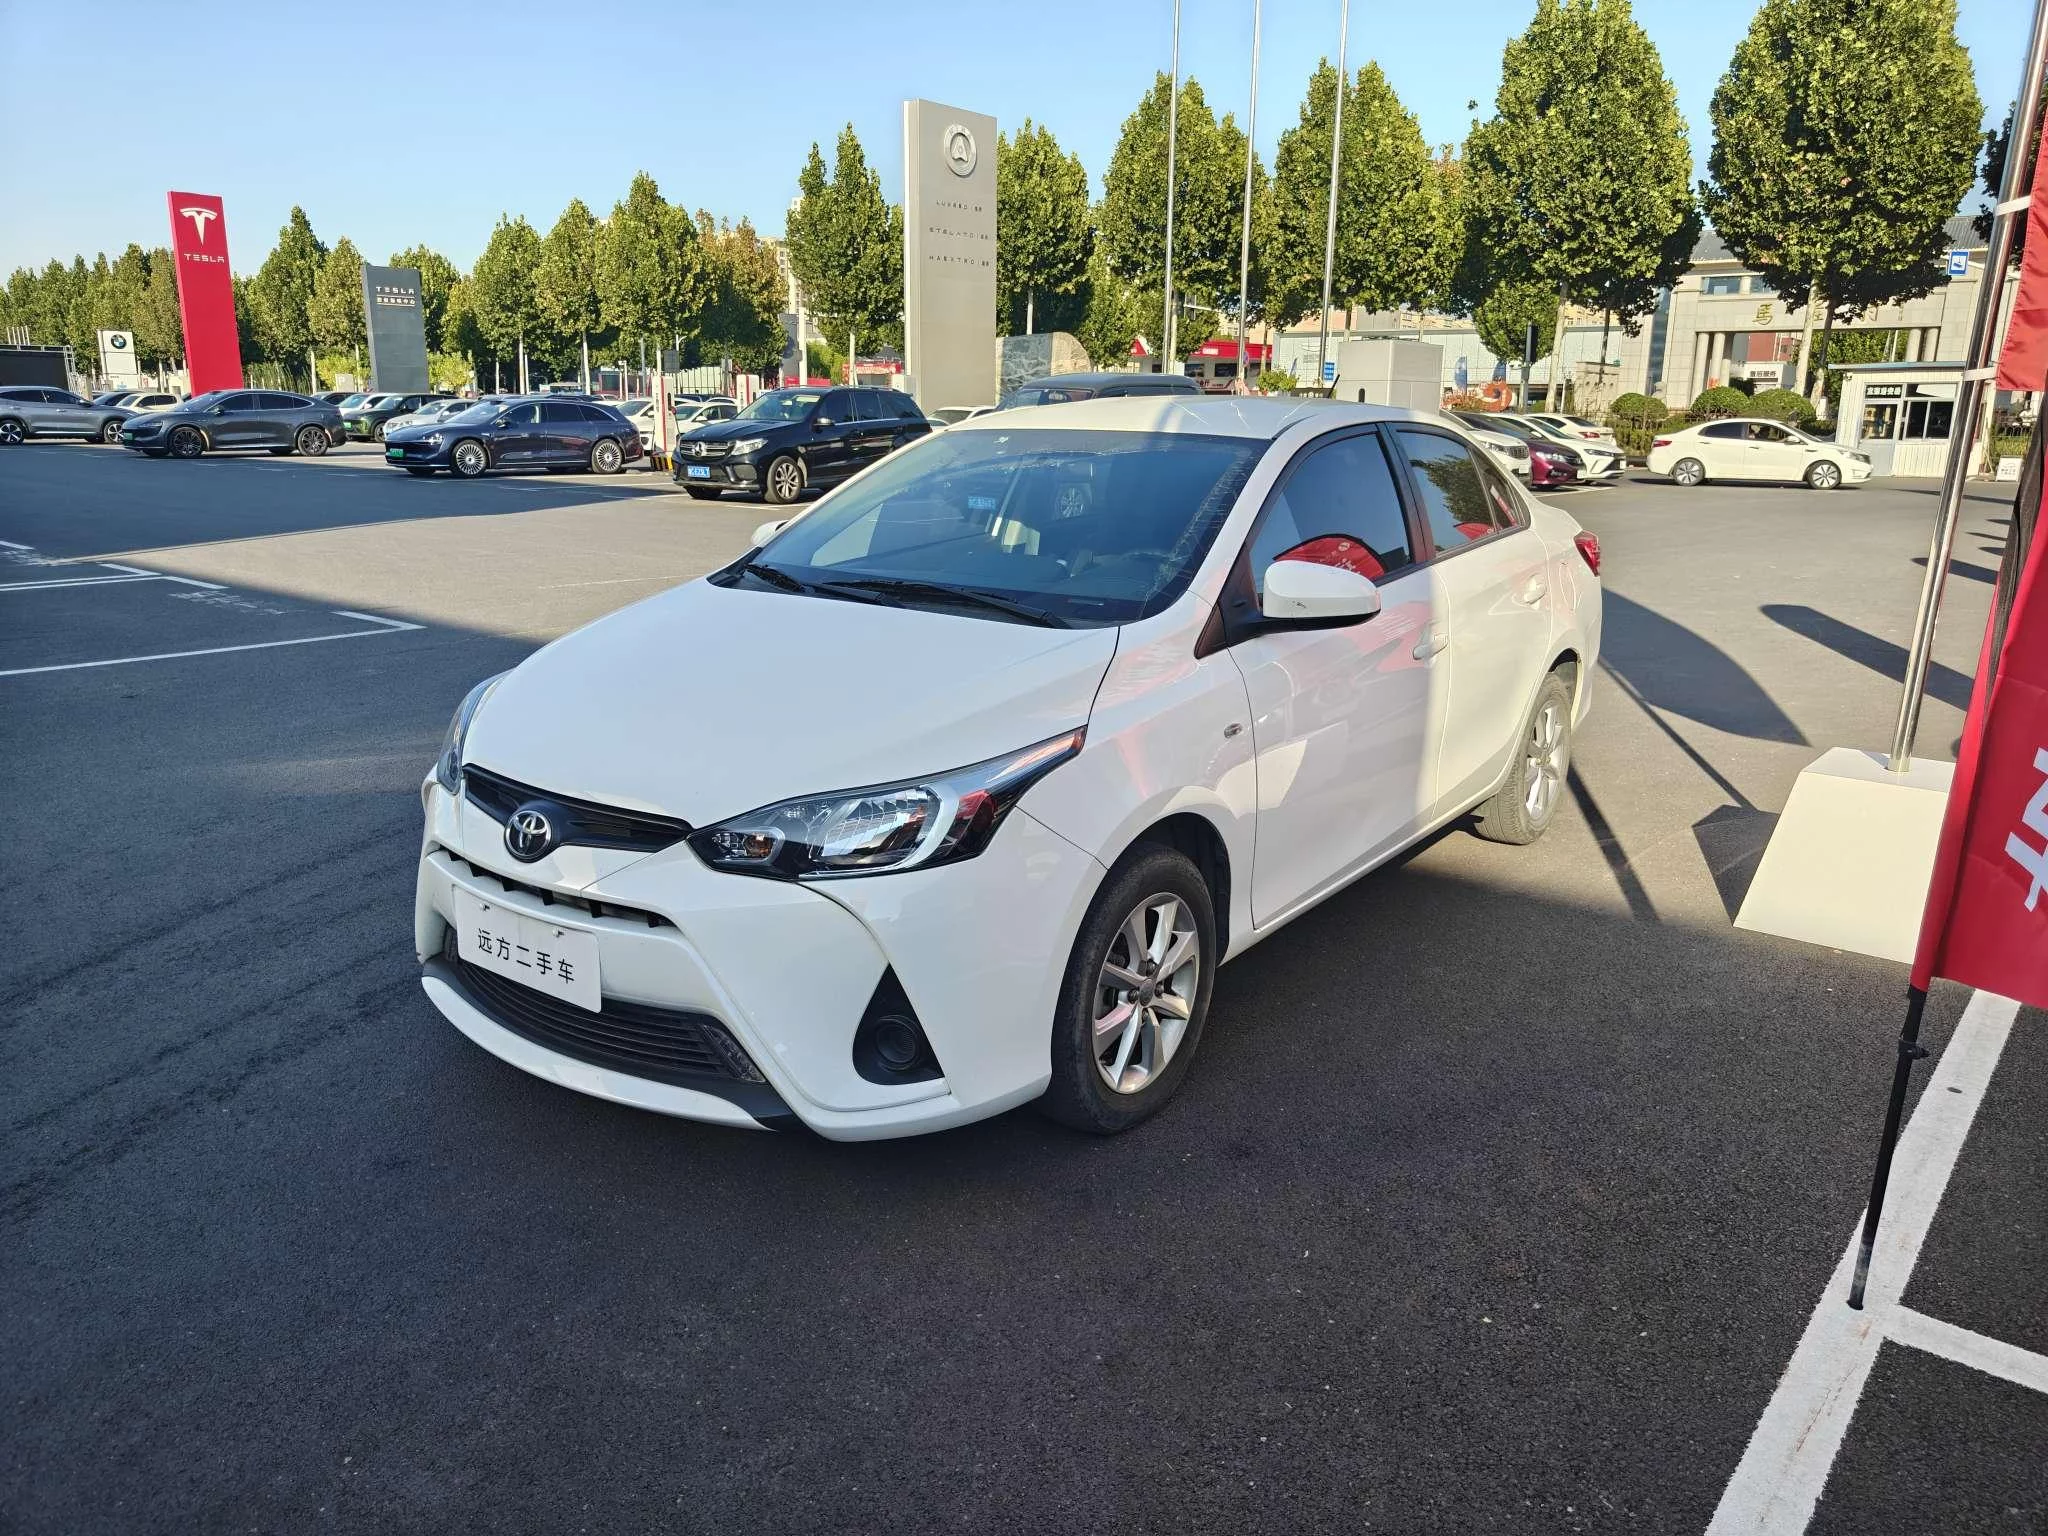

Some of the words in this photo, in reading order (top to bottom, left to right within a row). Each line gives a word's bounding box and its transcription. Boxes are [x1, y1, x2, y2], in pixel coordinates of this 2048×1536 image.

[183, 253, 225, 264] TESLA
[376, 286, 415, 295] TESLA
[477, 927, 575, 984] 远方二手车
